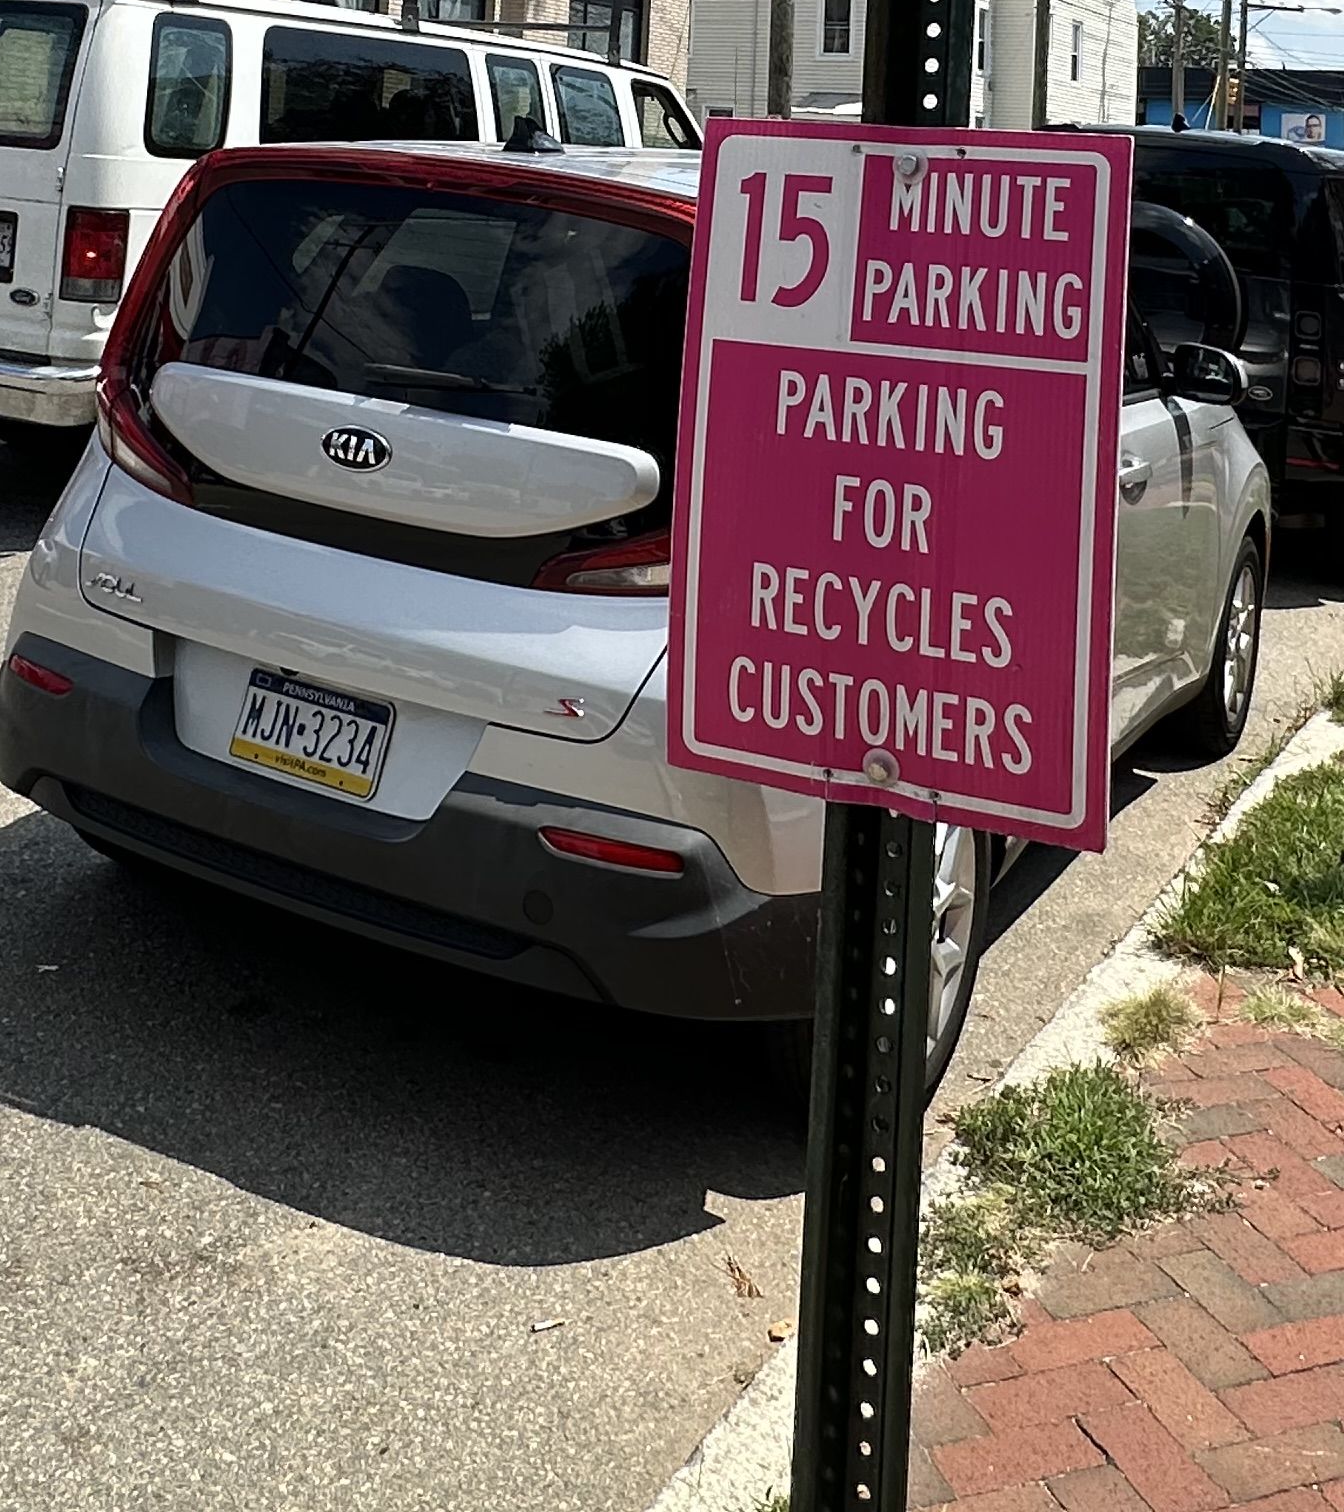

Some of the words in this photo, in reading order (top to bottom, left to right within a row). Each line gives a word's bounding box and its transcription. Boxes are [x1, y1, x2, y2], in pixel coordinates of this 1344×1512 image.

[740, 171, 834, 309] 15
[888, 173, 1072, 242] MINUTE
[861, 260, 1084, 340] PARKING
[328, 431, 377, 465] KIA
[776, 370, 1006, 461] PARKING
[831, 474, 933, 555] FOR
[750, 561, 1014, 669] RECYCLES
[282, 681, 356, 712] PENNSYLVANIA
[728, 655, 1034, 775] CUSTOMERS
